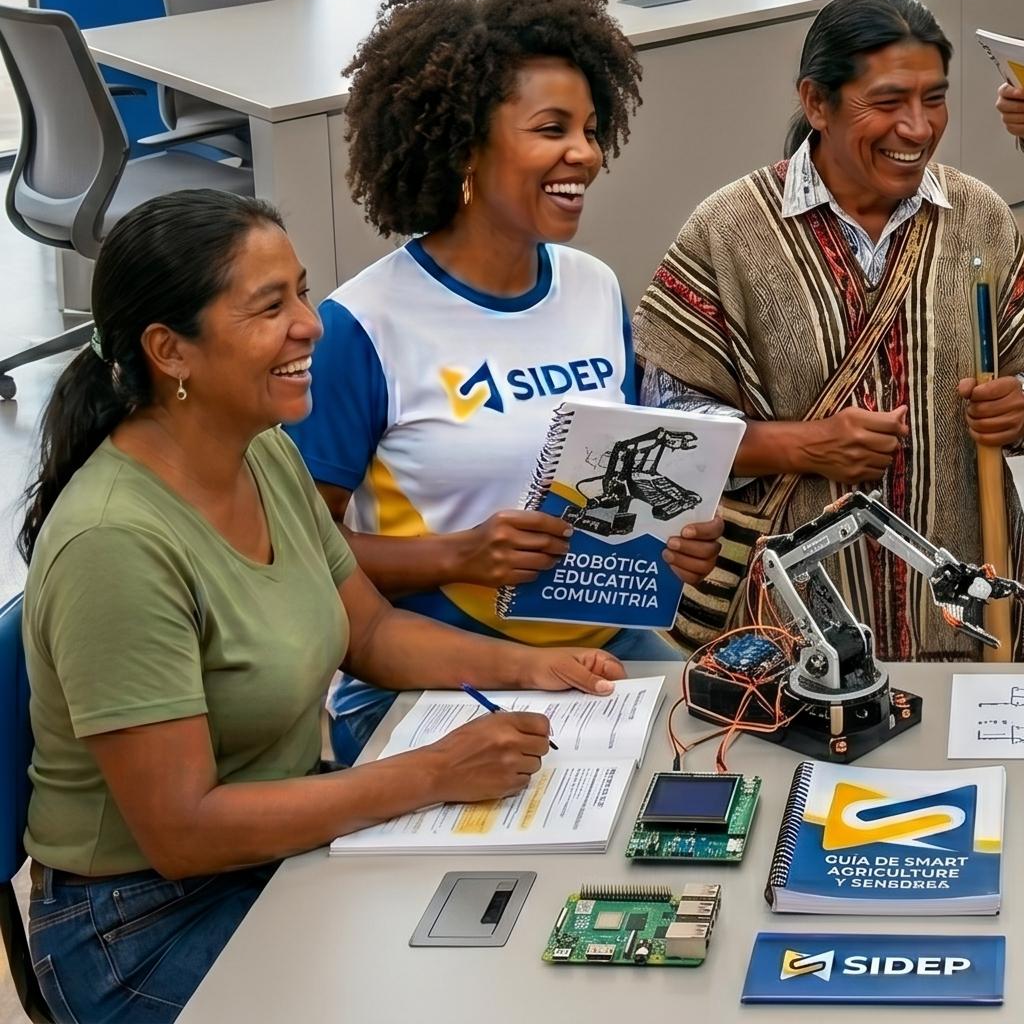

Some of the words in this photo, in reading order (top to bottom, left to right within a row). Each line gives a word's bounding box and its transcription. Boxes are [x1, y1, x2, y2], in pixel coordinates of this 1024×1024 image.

[506, 356, 614, 401] SIDEP
[563, 553, 659, 575] ROBÓTICA
[553, 569, 658, 592] EDUCATIVA
[541, 586, 659, 608] COMUNITRIA
[827, 866, 960, 878] AGRICULTURE
[875, 856, 900, 867] DE
[904, 856, 969, 867] SMART
[834, 878, 847, 887] Y
[842, 955, 972, 975] SIDEP
